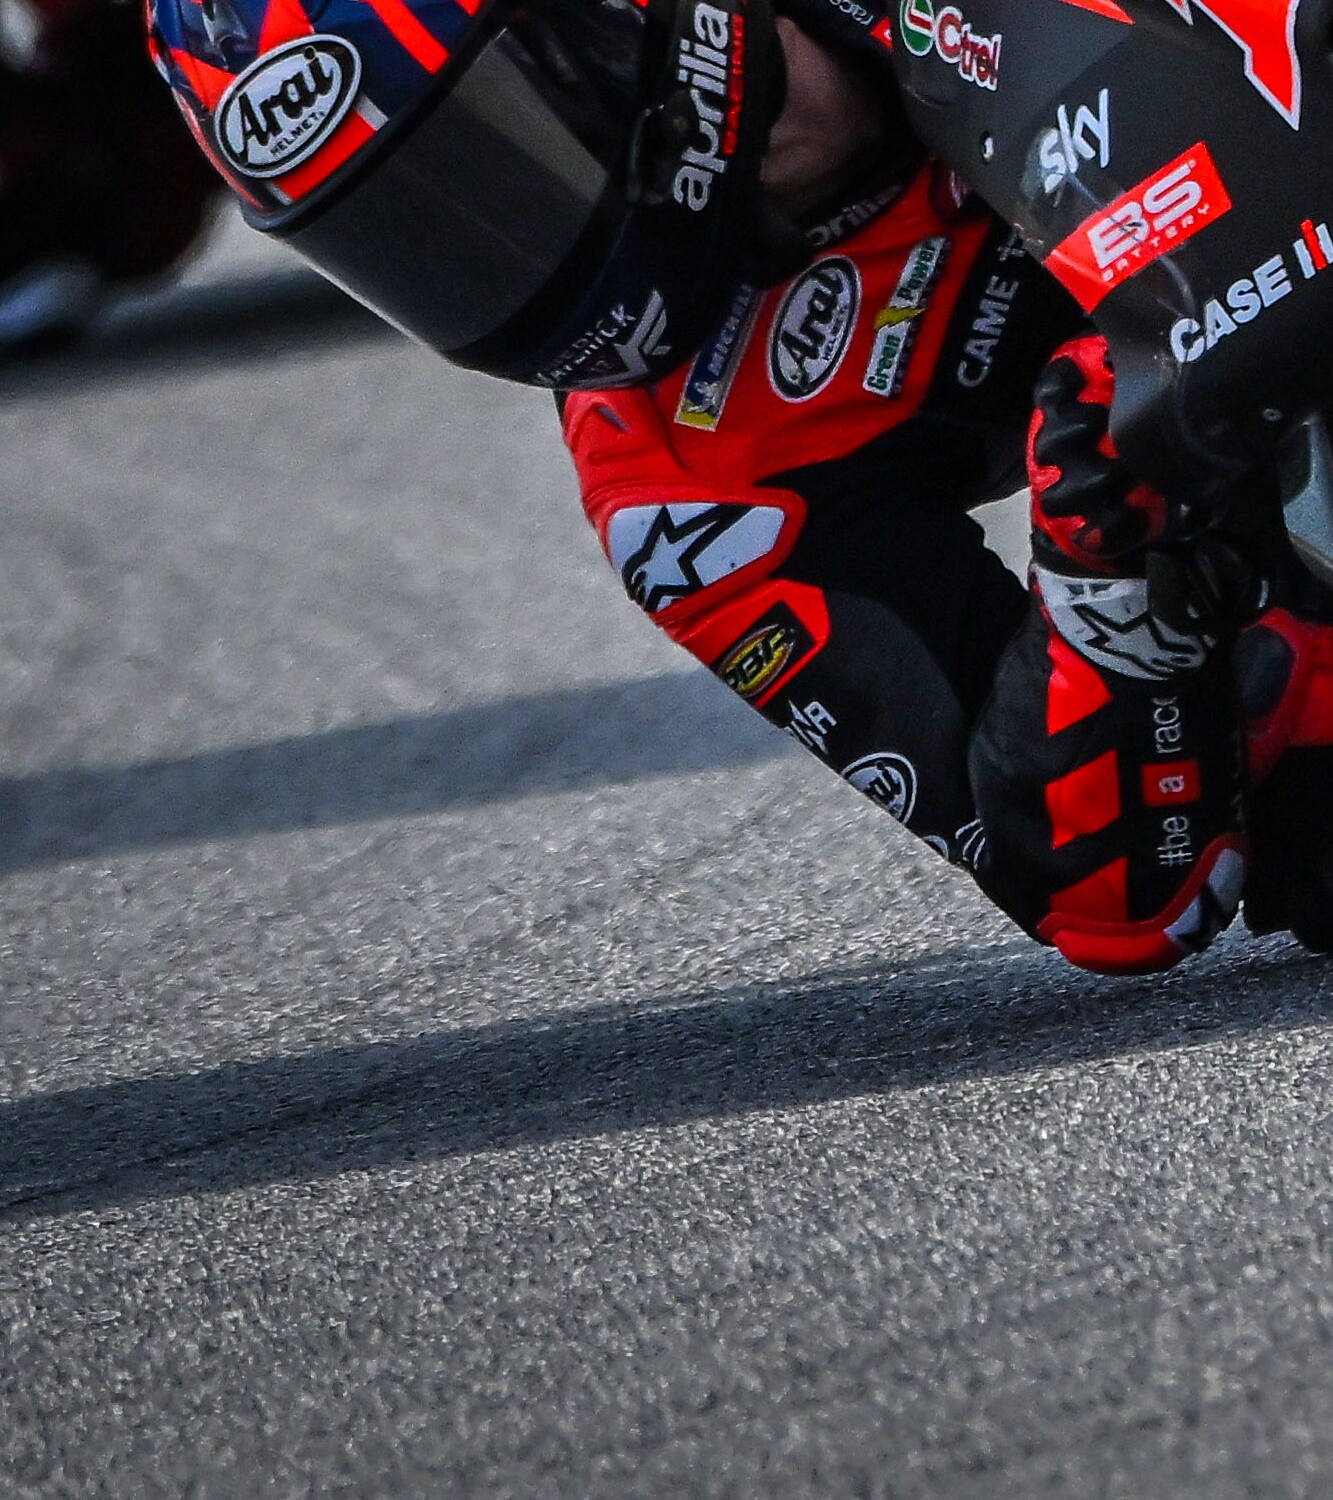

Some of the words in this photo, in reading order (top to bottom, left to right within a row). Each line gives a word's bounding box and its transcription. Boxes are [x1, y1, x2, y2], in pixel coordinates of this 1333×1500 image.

[235, 45, 335, 165] Arai
[672, 2, 730, 212] aprilia
[1039, 87, 1110, 195] sky
[1086, 161, 1203, 270] BS
[1102, 203, 1210, 283] BATTERY
[779, 268, 845, 392] Arai
[865, 334, 901, 391] Green
[956, 274, 1020, 388] CAME
[1169, 253, 1294, 364] CASE
[1158, 774, 1186, 794] a
[1156, 814, 1193, 868] #be
